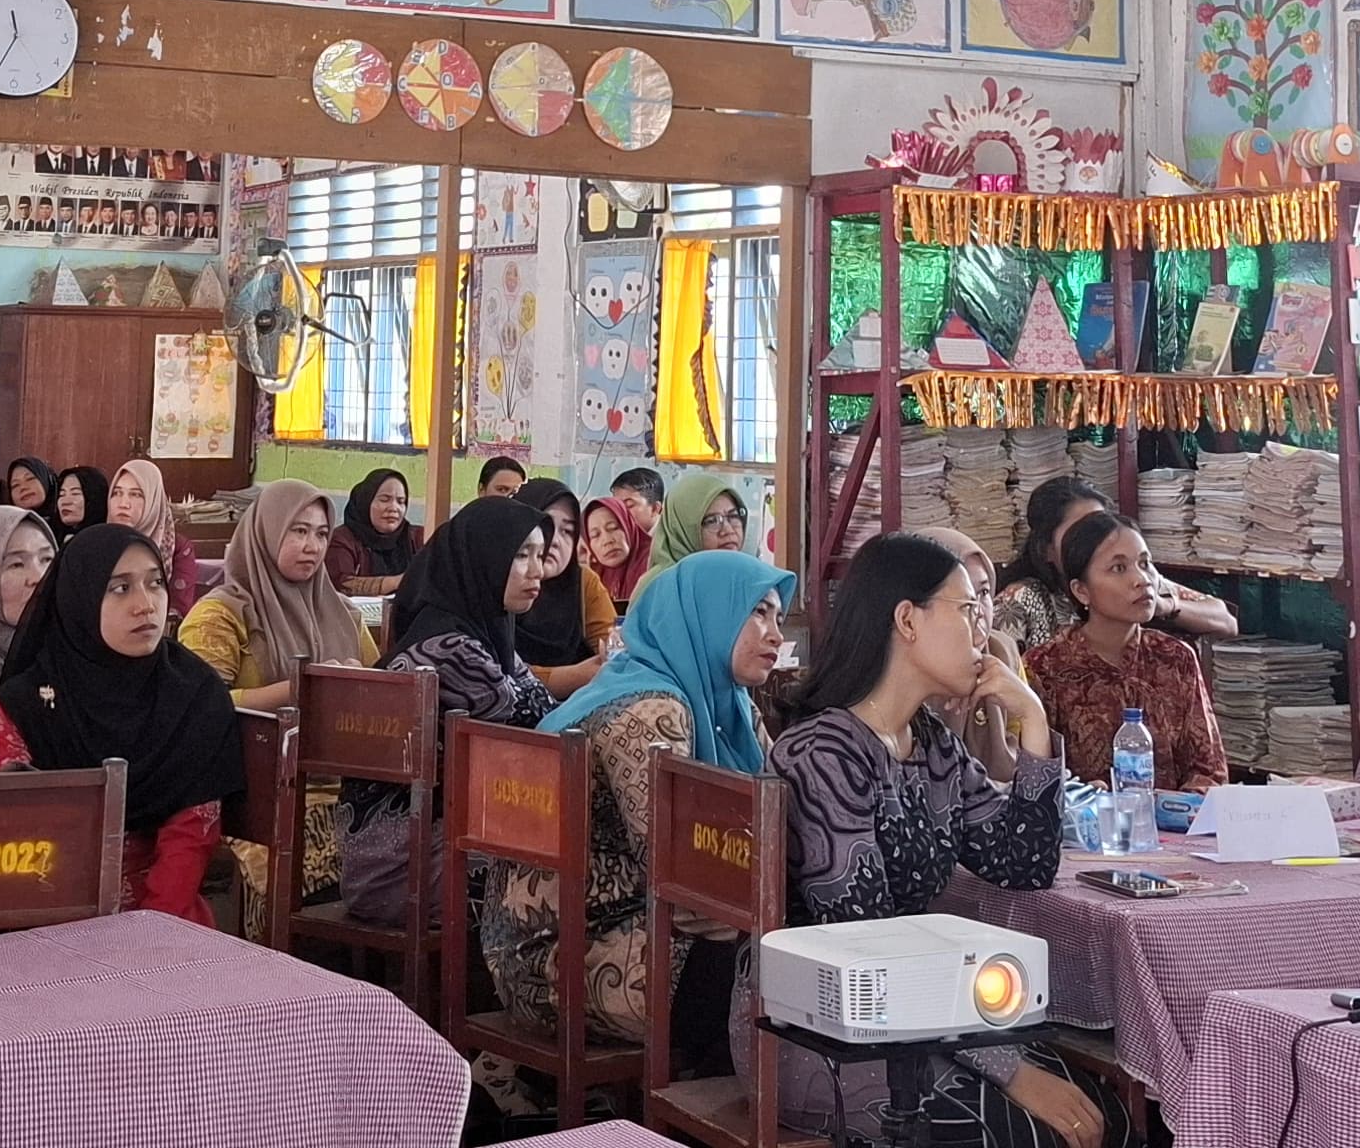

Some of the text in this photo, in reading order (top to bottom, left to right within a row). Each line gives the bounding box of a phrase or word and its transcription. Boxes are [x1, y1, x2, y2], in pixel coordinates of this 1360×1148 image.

[54, 8, 63, 20] 2
[60, 33, 69, 44] 3
[437, 41, 447, 54] D
[52, 57, 60, 67] 4
[9, 77, 19, 89] 6
[34, 73, 42, 85] 5
[468, 84, 482, 98] A
[446, 116, 457, 130] B
[29, 183, 190, 202] Wakil Presiden Republik Indonesia
[693, 822, 752, 870] BOS 2022
